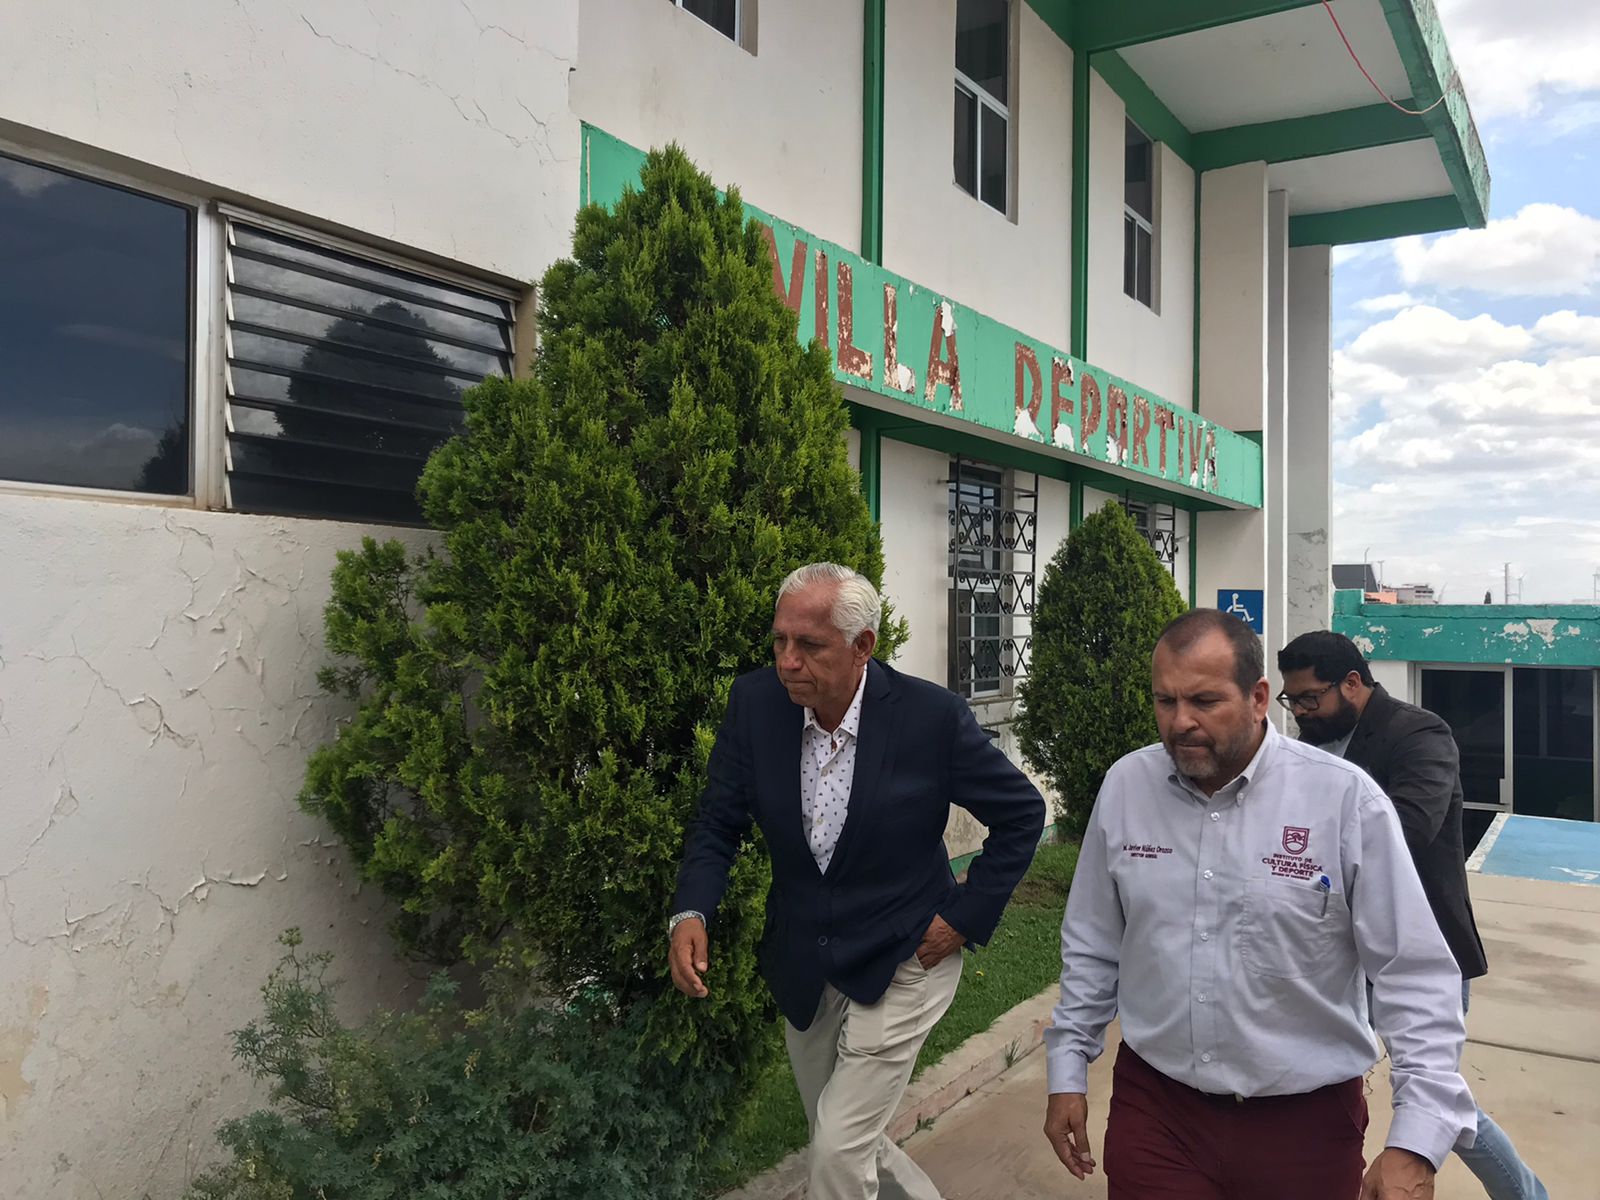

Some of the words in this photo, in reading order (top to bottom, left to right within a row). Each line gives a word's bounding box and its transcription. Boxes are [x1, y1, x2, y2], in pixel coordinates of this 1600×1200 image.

[758, 221, 963, 411] VILLA
[1014, 341, 1218, 490] DEPORTIVA
[1262, 858, 1297, 868] CULTURA
[1300, 862, 1323, 872] FÍSICA
[1279, 867, 1314, 877] DEPORTE
